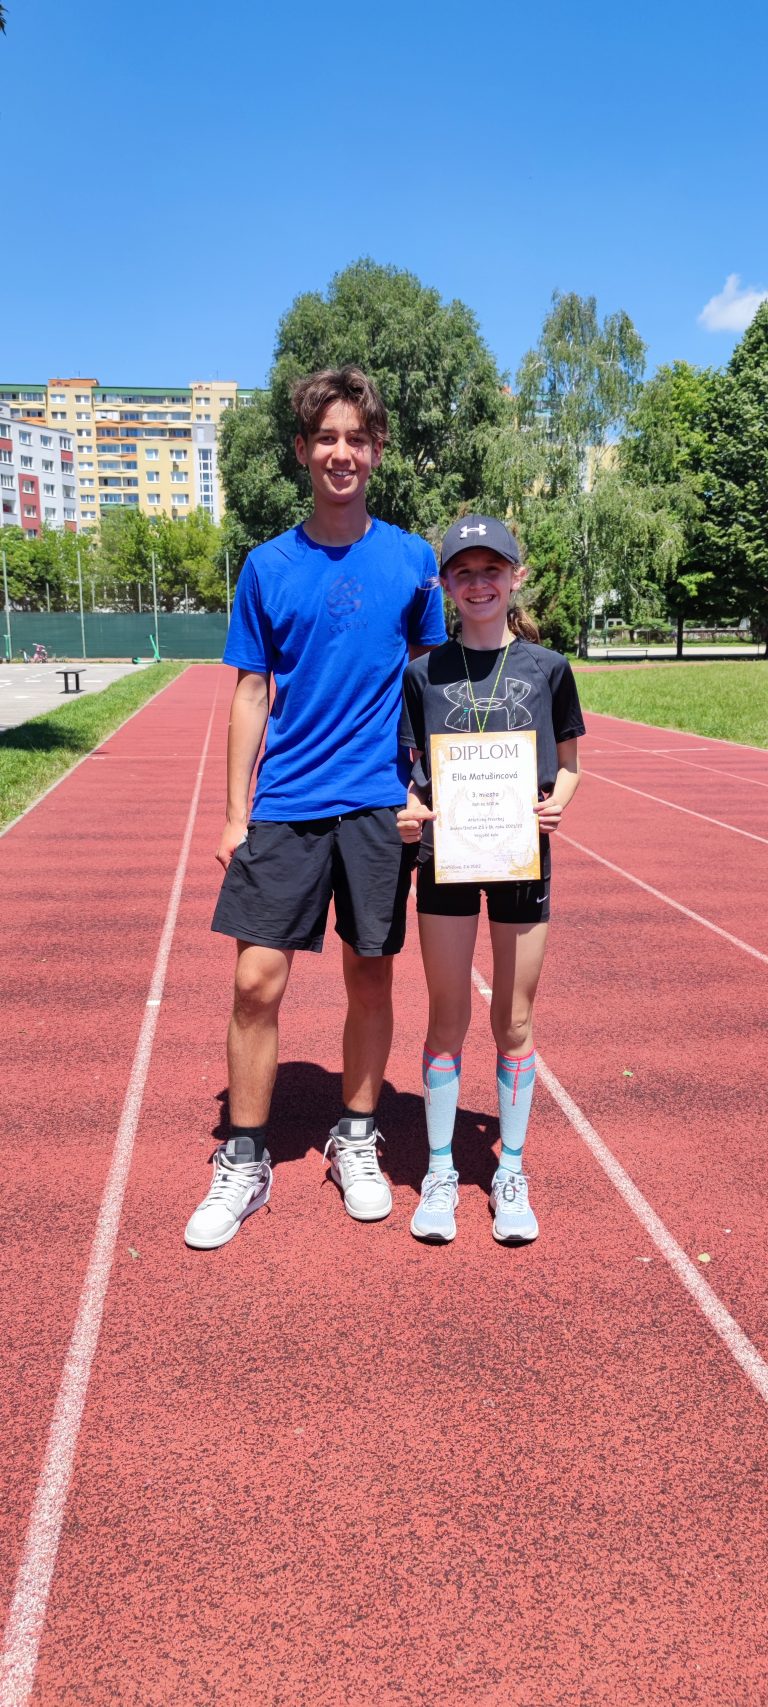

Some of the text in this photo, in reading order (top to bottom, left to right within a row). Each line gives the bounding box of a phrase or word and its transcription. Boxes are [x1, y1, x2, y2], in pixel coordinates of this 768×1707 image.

[449, 744, 519, 761] DIPLOM
[452, 771, 518, 781] Ella Matušincová
